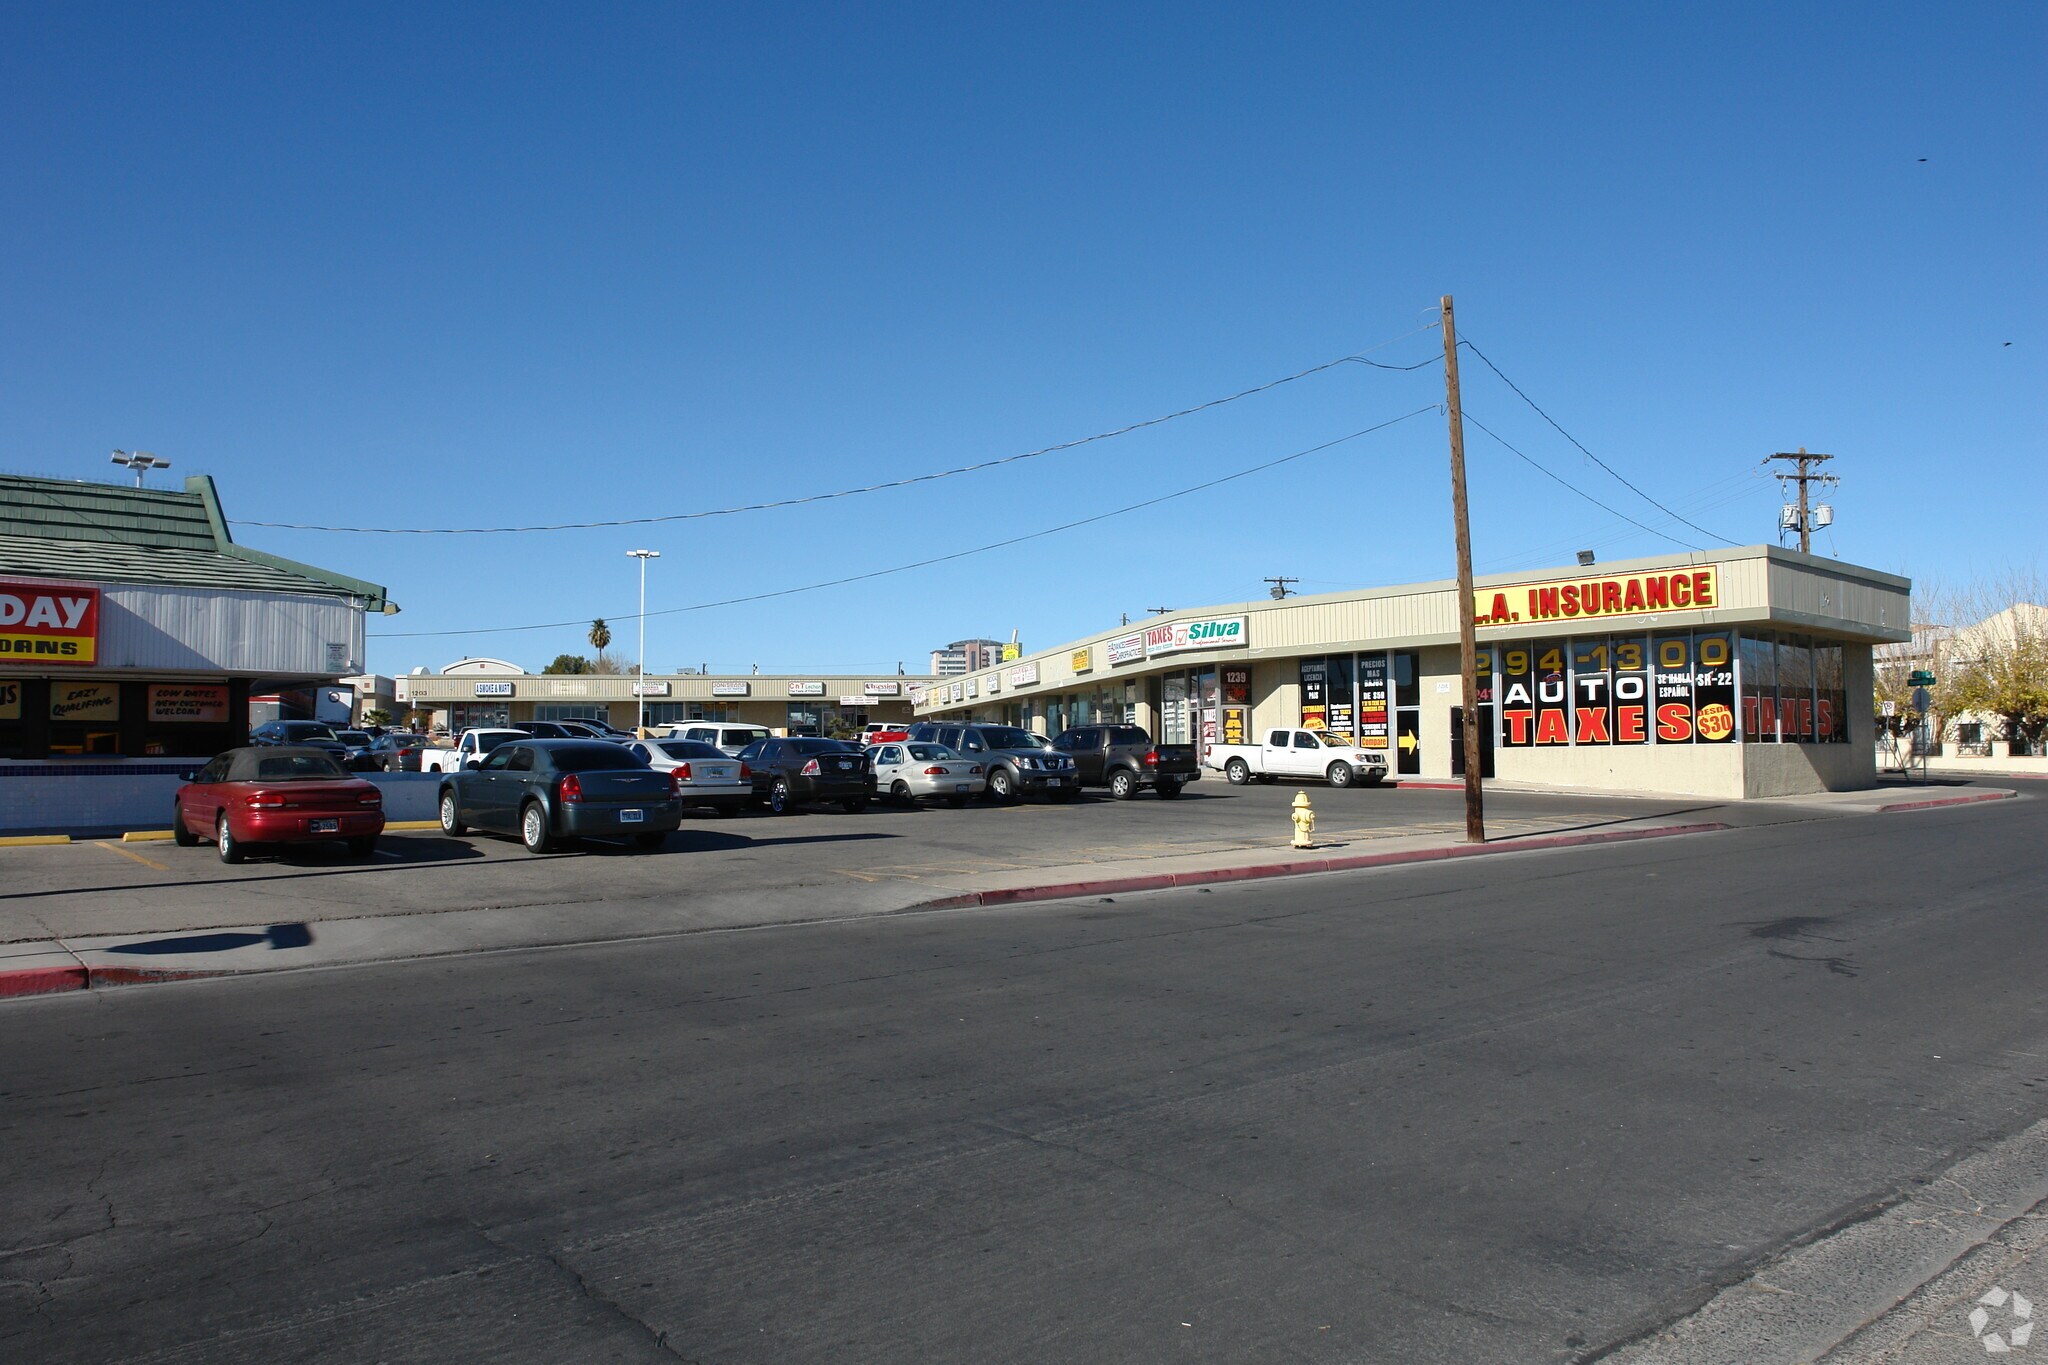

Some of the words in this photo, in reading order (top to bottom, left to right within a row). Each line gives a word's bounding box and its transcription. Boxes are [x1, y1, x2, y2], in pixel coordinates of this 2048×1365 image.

[1529, 572, 1713, 620] INSURANCE
[0, 594, 90, 629] DAY
[1147, 625, 1173, 646] TAXES
[1189, 622, 1240, 640] Silva
[1361, 660, 1386, 669] PRECIOS
[1226, 672, 1246, 682] 1239
[1367, 670, 1380, 678] MAS
[1658, 674, 1667, 684] SE
[1669, 673, 1691, 684] HABLA
[1697, 672, 1732, 686] SR-22
[67, 687, 100, 701] EAZY
[1363, 692, 1371, 700] DE
[1503, 677, 1644, 705] AUTO
[1659, 685, 1690, 698] ESPAÑOL
[155, 708, 202, 716] WELCOME
[1697, 705, 1730, 717] DESDE
[1743, 696, 1832, 735] TAXES
[1503, 702, 1693, 744] TAXES
[1699, 712, 1733, 736] $30
[1361, 737, 1387, 746] Compare
